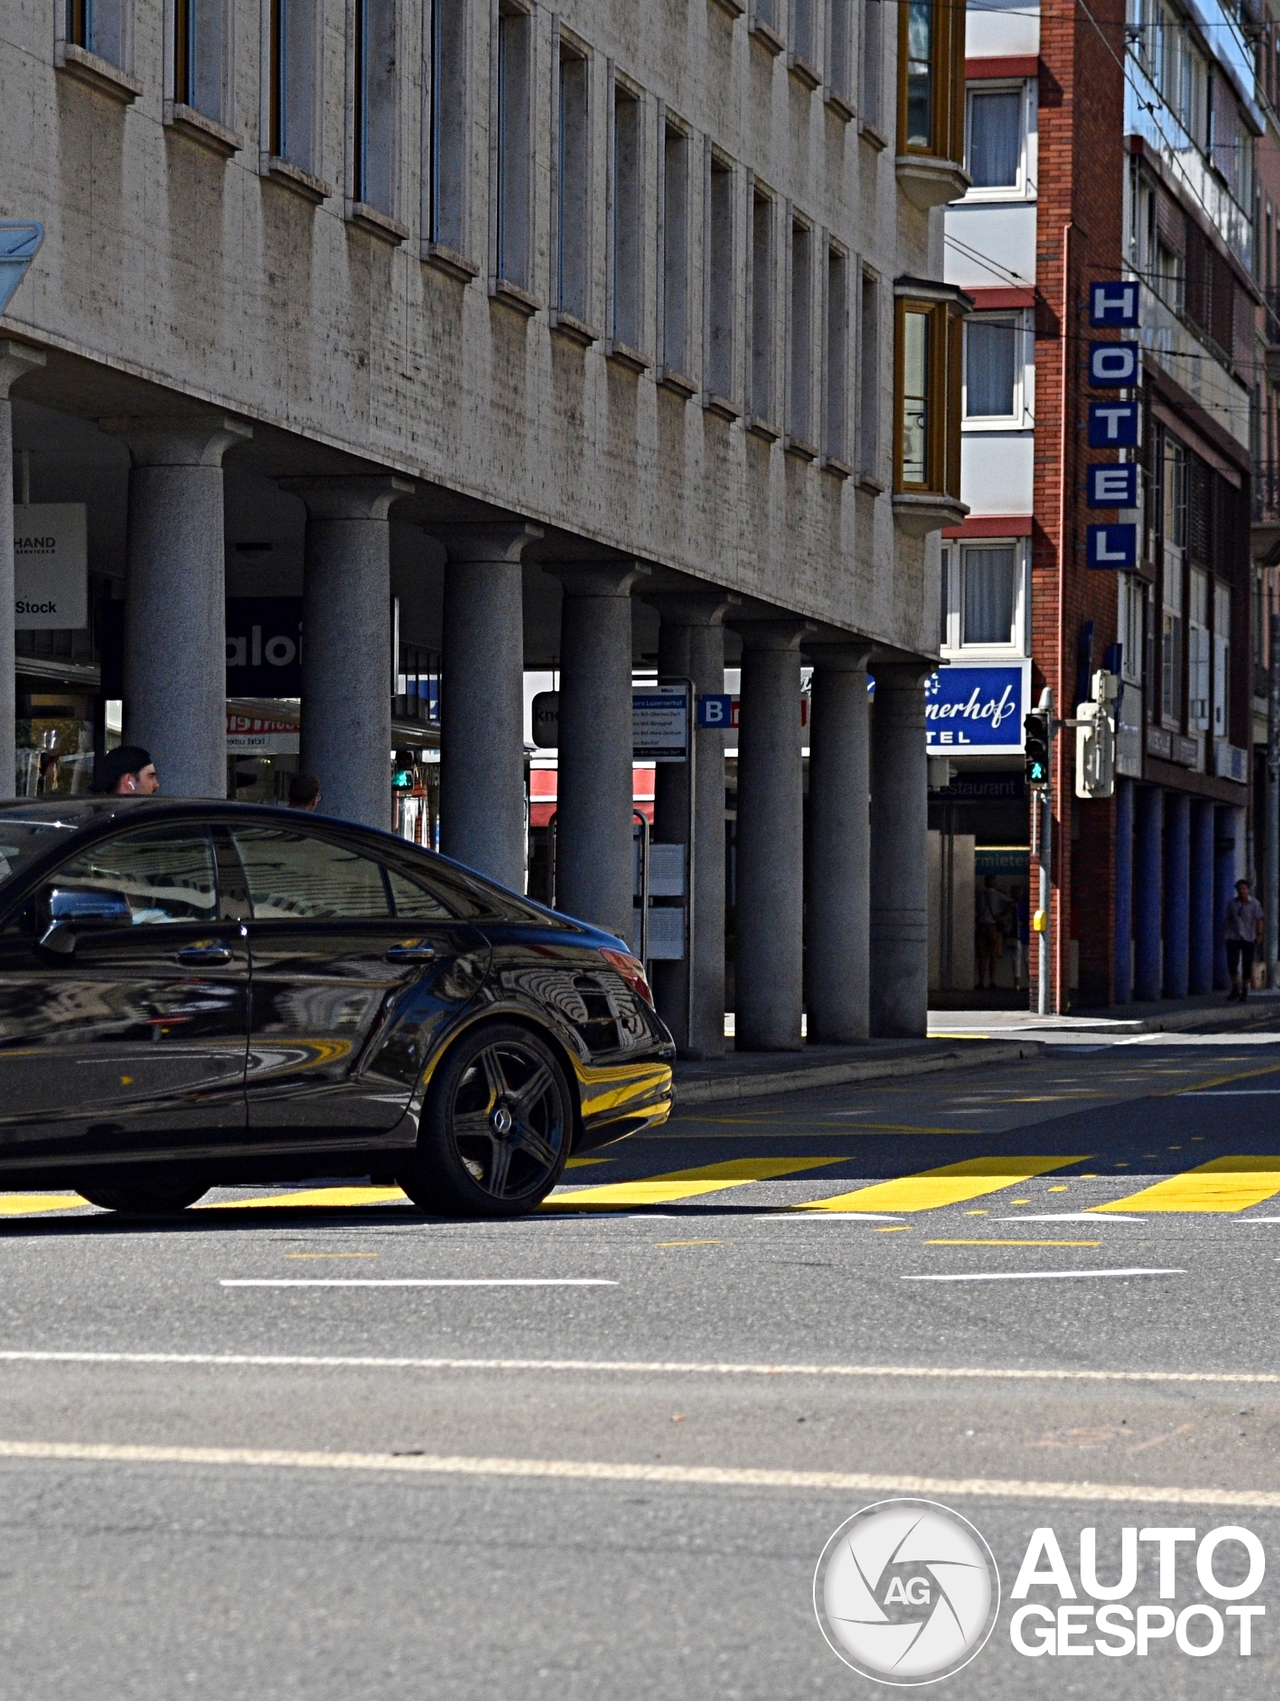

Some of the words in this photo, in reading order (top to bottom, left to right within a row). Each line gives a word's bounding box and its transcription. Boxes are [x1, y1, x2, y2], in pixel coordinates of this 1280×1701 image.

[1093, 288, 1134, 560] HOTEL
[15, 601, 57, 613] Stock
[705, 701, 723, 722] B
